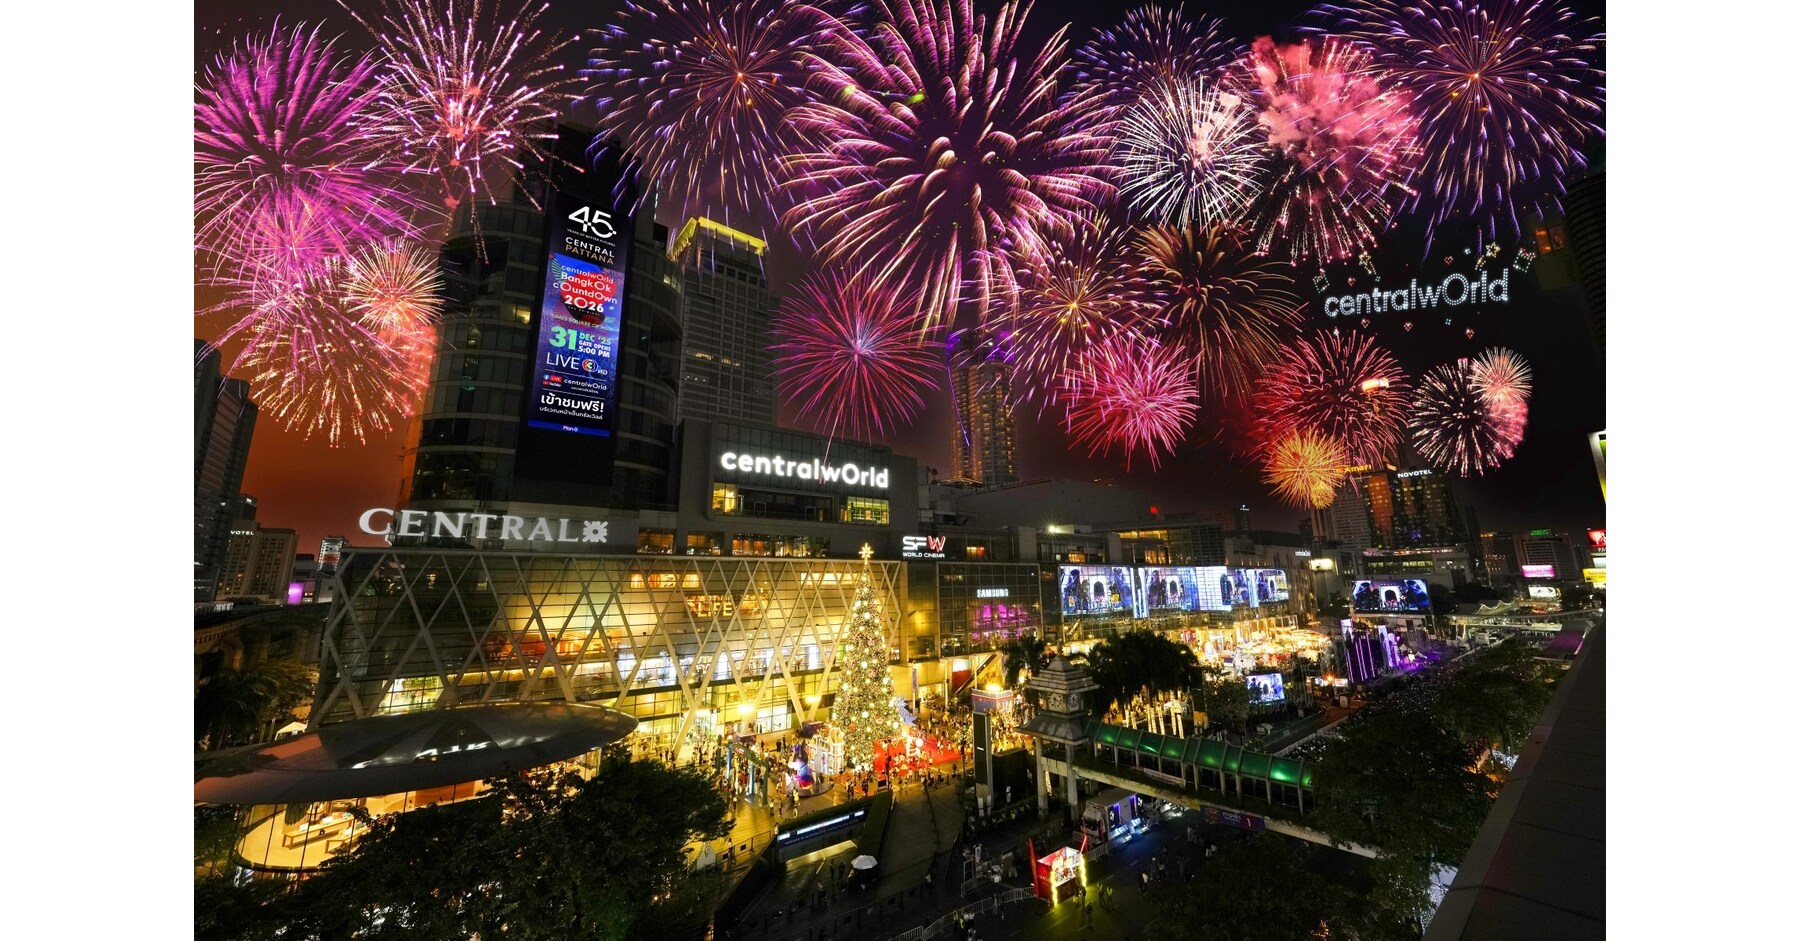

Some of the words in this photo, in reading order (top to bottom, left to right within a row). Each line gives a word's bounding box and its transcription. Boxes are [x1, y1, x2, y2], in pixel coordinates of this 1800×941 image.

[568, 206, 617, 238] 45
[565, 236, 615, 258] CENTRAL
[565, 244, 614, 265] PATTANA
[561, 265, 614, 284] centralwOrld
[561, 272, 612, 292] BangkOk
[553, 282, 618, 304] cOuntdOwn
[1324, 268, 1510, 318] centralwOrld
[549, 326, 578, 351] 31
[578, 340, 593, 348] GATE
[593, 343, 612, 352] OPENS
[579, 332, 595, 341] DEC
[546, 352, 580, 370] LIVE
[577, 346, 596, 355] 5:00
[598, 350, 610, 358] PM
[563, 379, 607, 391] centralwOrld
[721, 452, 889, 488] centralwOrld
[1344, 464, 1372, 474] Amari
[1397, 469, 1433, 478] NOVOTEL
[359, 508, 581, 543] CENTRAL
[976, 588, 1009, 598] SAMSUNG
